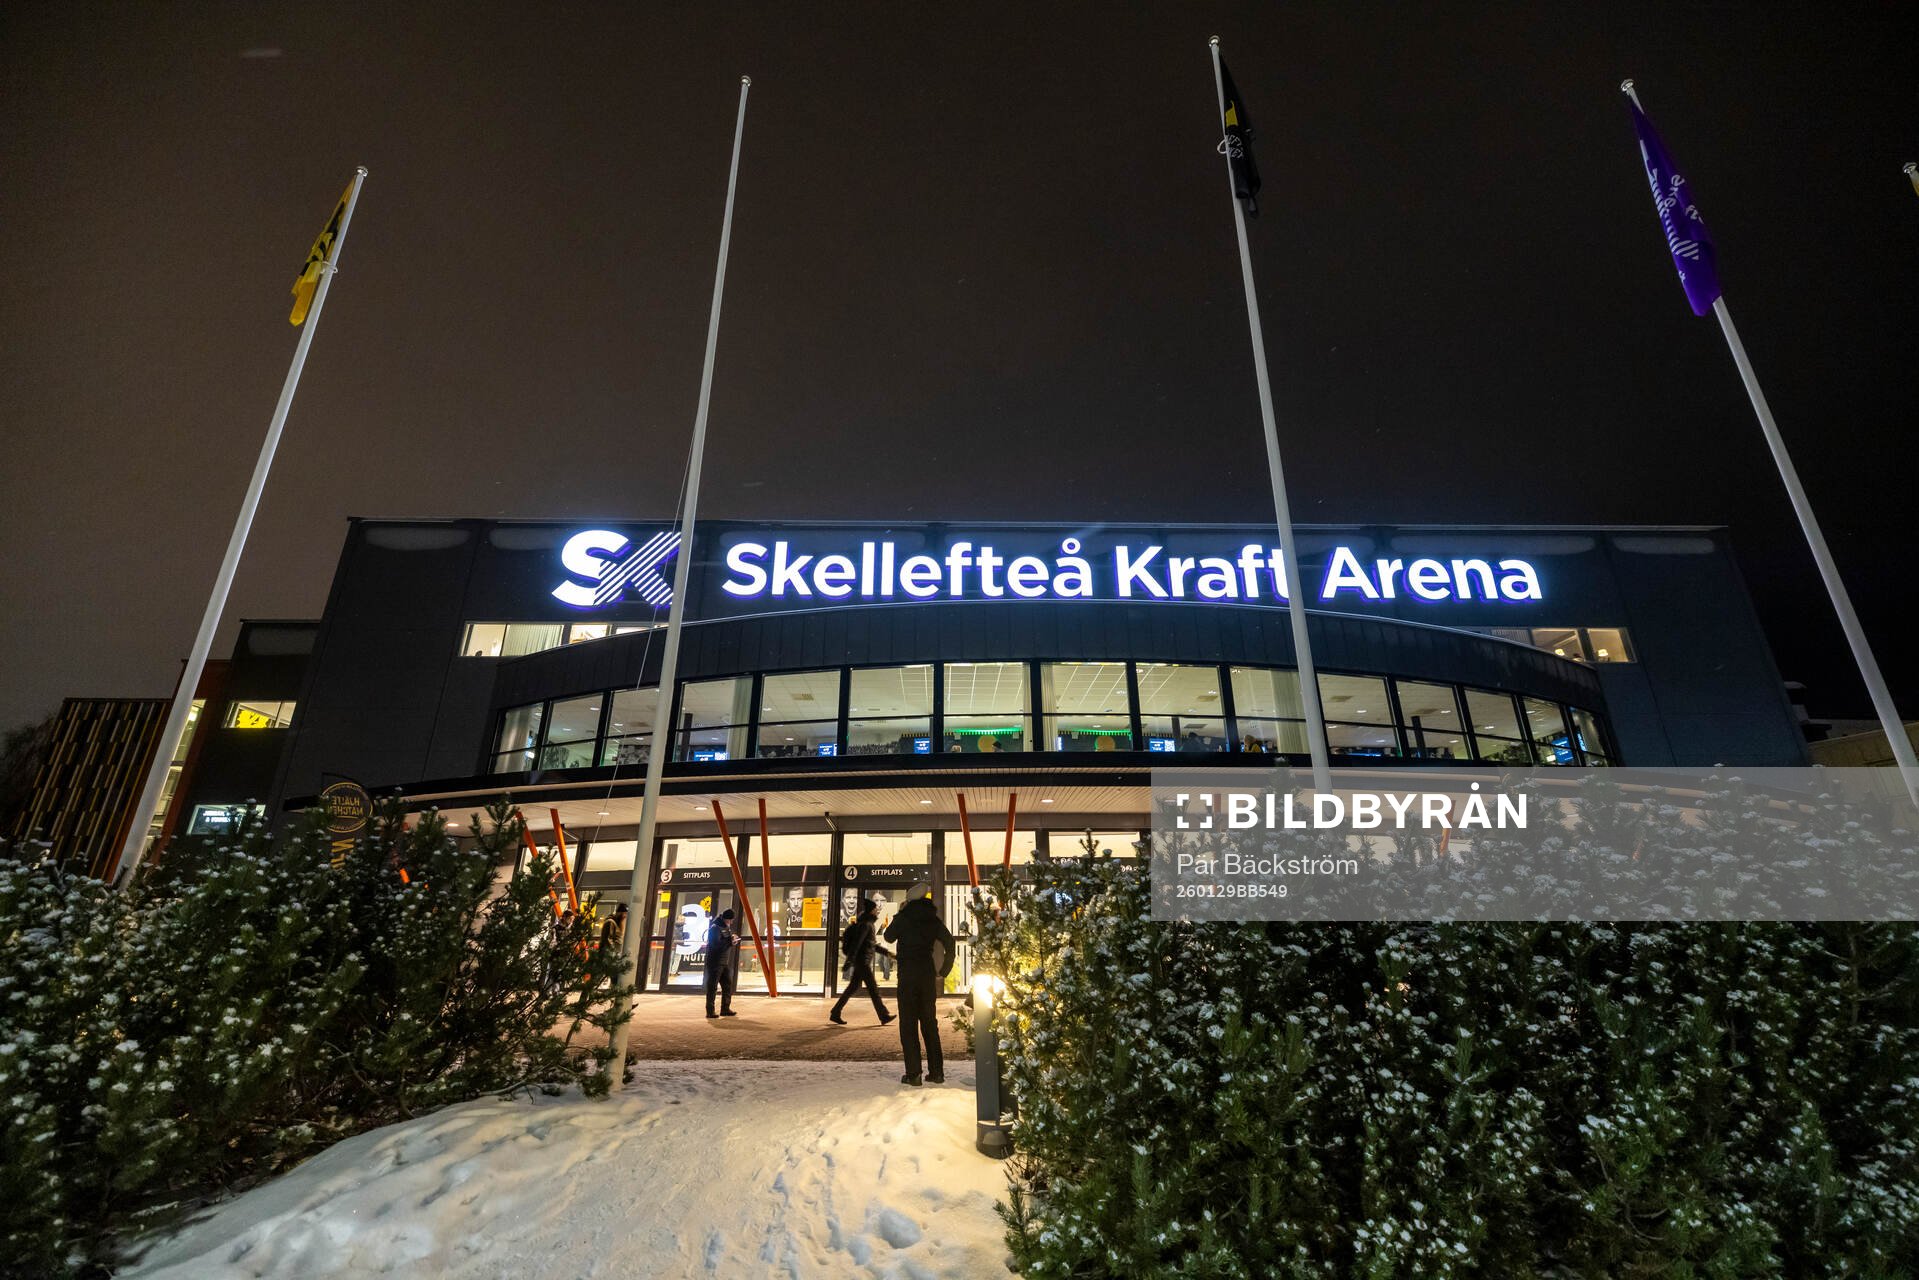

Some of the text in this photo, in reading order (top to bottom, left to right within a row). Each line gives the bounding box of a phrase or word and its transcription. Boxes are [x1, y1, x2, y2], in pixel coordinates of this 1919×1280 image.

[721, 538, 1543, 600] Skellefteå Kraft Arena
[871, 868, 903, 876] SITTPLATS
[682, 953, 706, 962] NUIT
